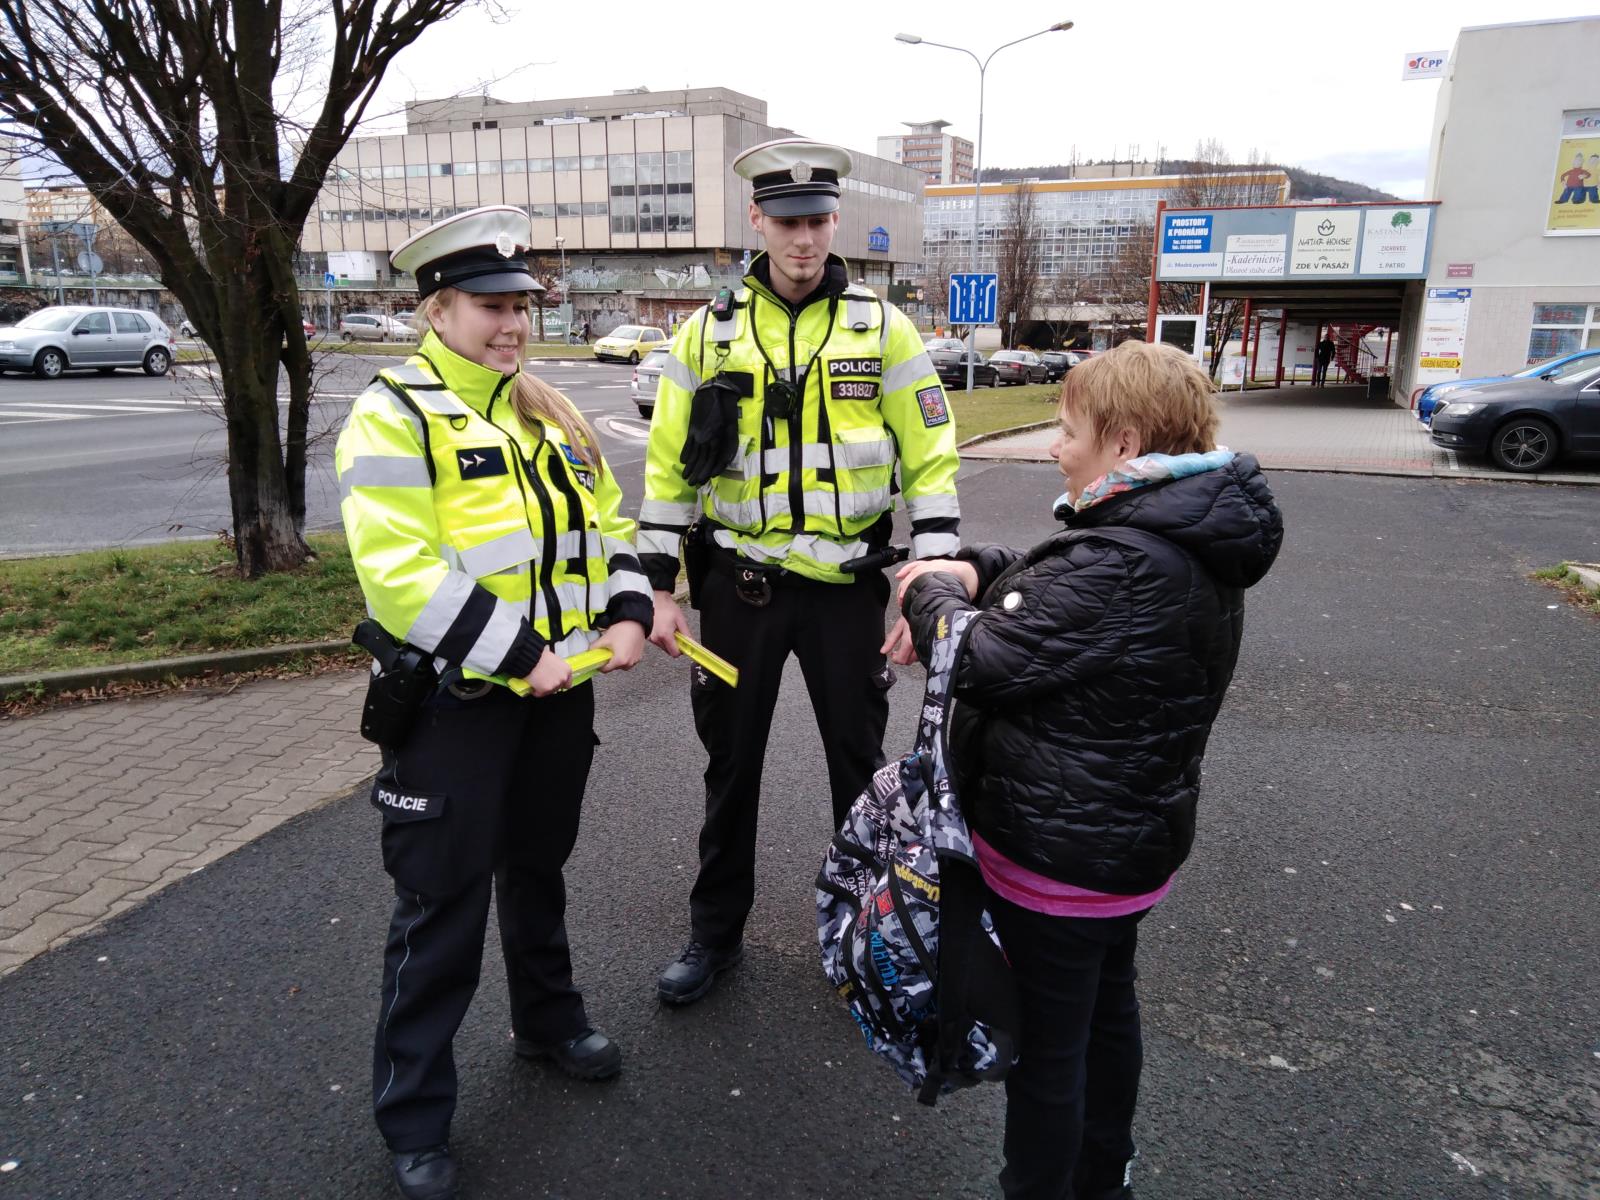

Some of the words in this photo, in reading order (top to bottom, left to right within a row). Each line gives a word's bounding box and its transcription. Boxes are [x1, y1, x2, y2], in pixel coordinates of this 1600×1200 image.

[1172, 218, 1206, 226] PROSTORY
[830, 361, 881, 373] POLICIE
[838, 383, 874, 396] 331827
[378, 789, 428, 811] POLICIE
